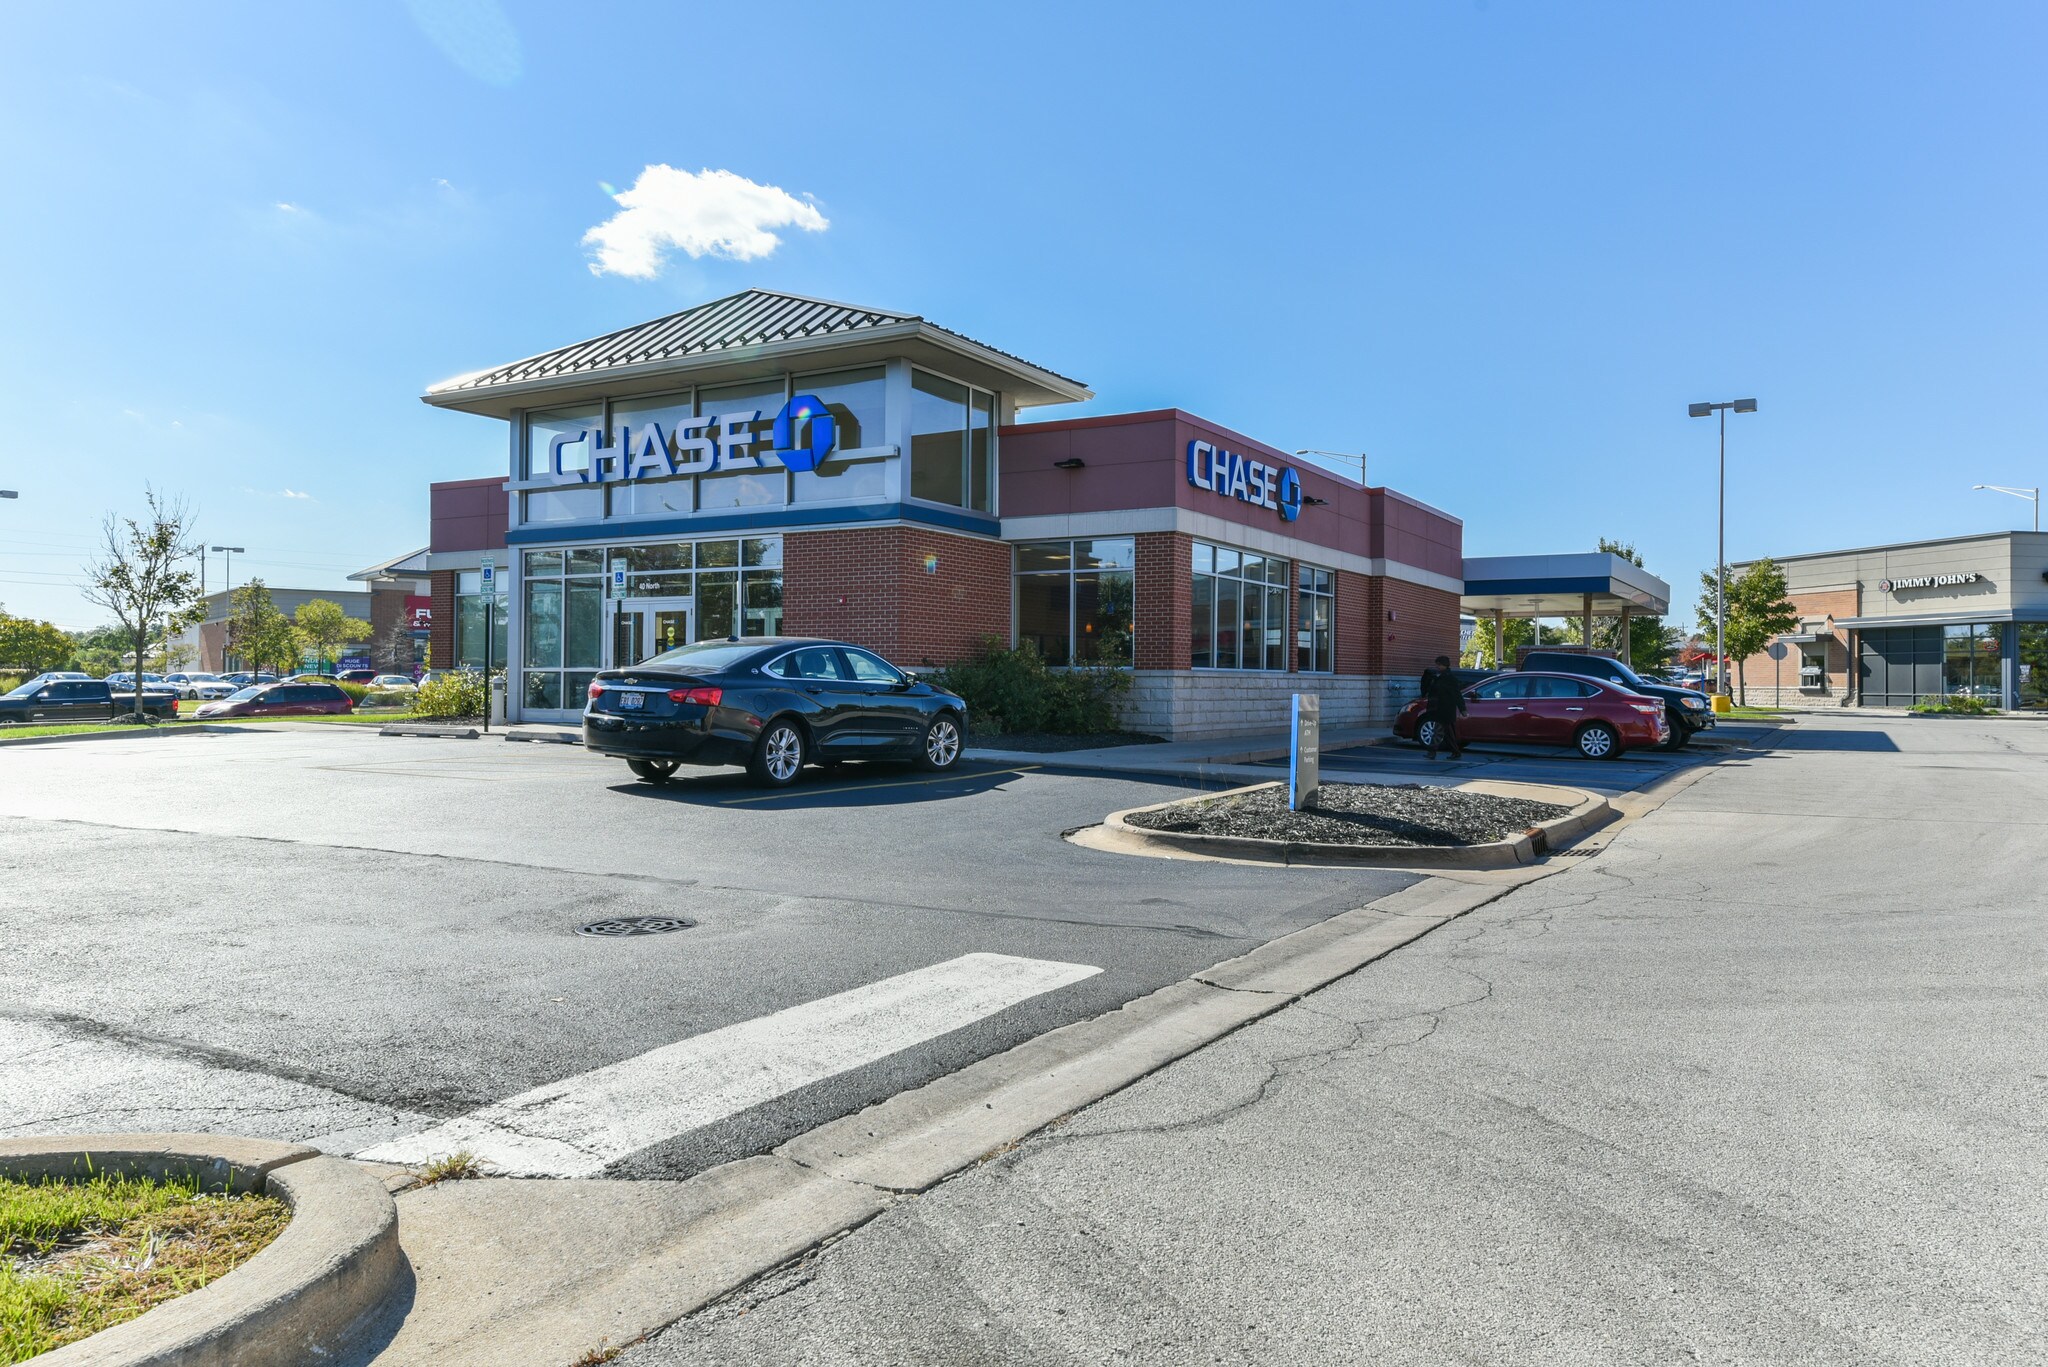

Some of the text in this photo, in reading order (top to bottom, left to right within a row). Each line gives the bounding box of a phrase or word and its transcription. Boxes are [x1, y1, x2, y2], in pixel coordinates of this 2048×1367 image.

[549, 410, 762, 486] CHASE
[1188, 440, 1278, 511] CHASE
[646, 582, 660, 590] North
[1893, 577, 1932, 591] JIMMY
[1934, 573, 1977, 588] JOHN'S
